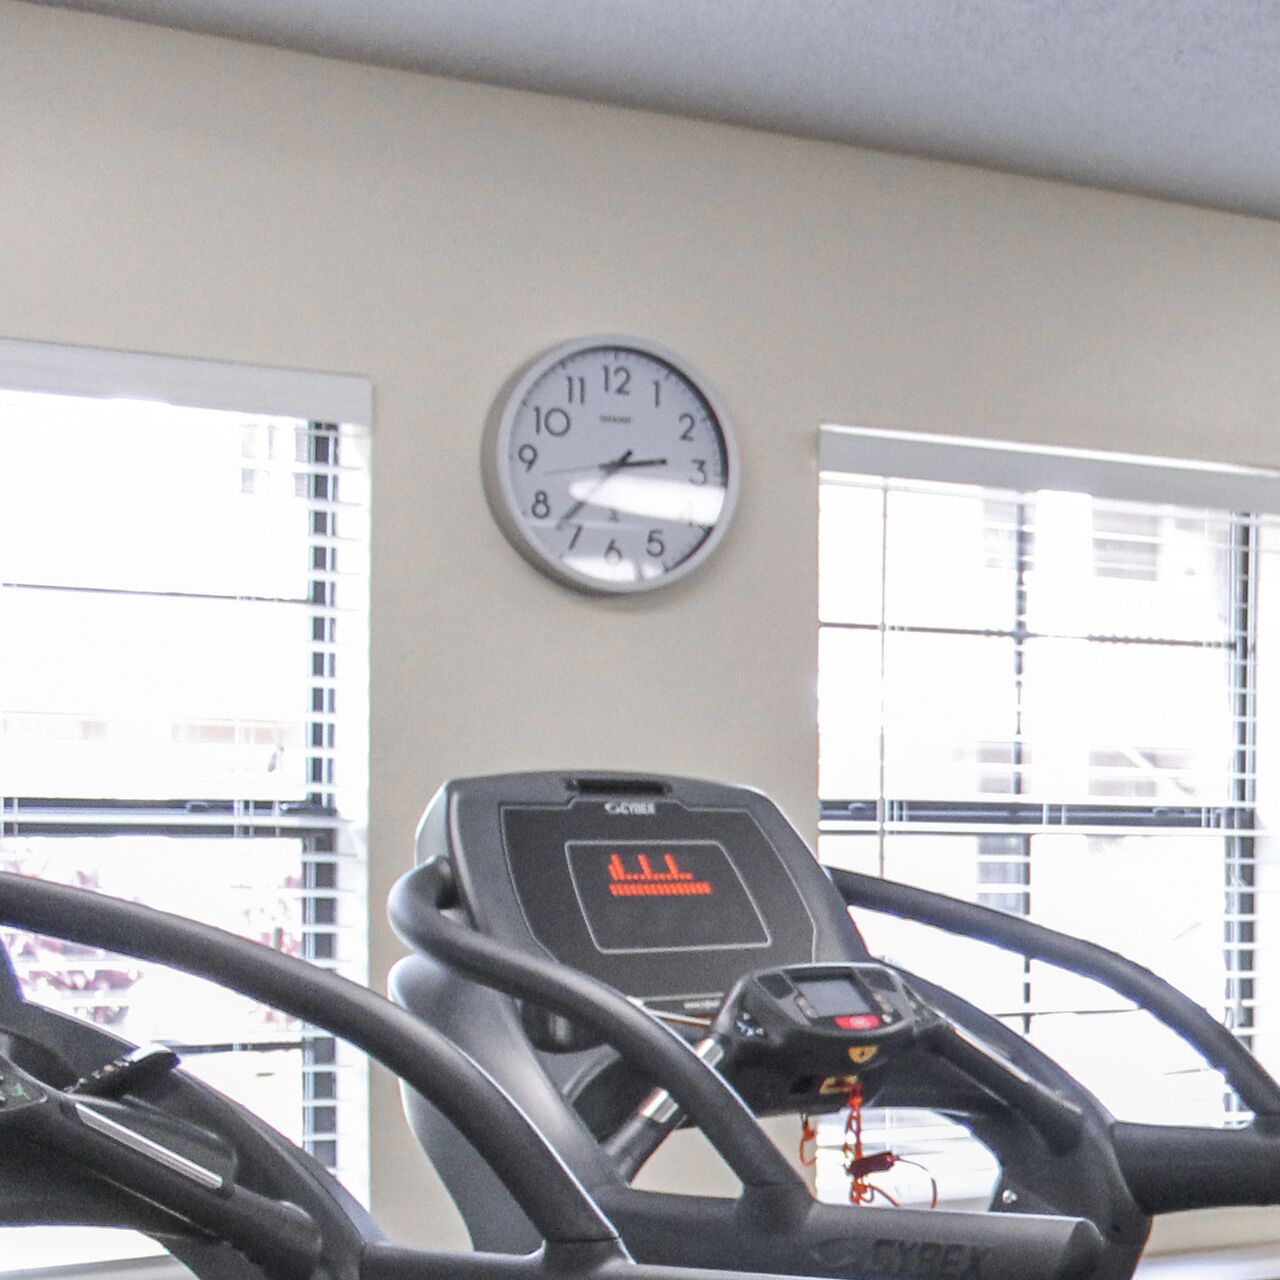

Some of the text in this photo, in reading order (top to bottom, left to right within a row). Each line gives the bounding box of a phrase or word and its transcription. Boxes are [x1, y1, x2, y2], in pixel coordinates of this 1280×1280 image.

[567, 375, 586, 405] 11
[602, 365, 631, 396] 12
[652, 380, 662, 408] 1
[533, 405, 571, 437] 10
[678, 412, 696, 442] 2
[517, 443, 538, 473] 9
[688, 458, 708, 485] 3
[530, 490, 551, 520] 8
[603, 538, 623, 565] 6
[646, 529, 665, 558] 5
